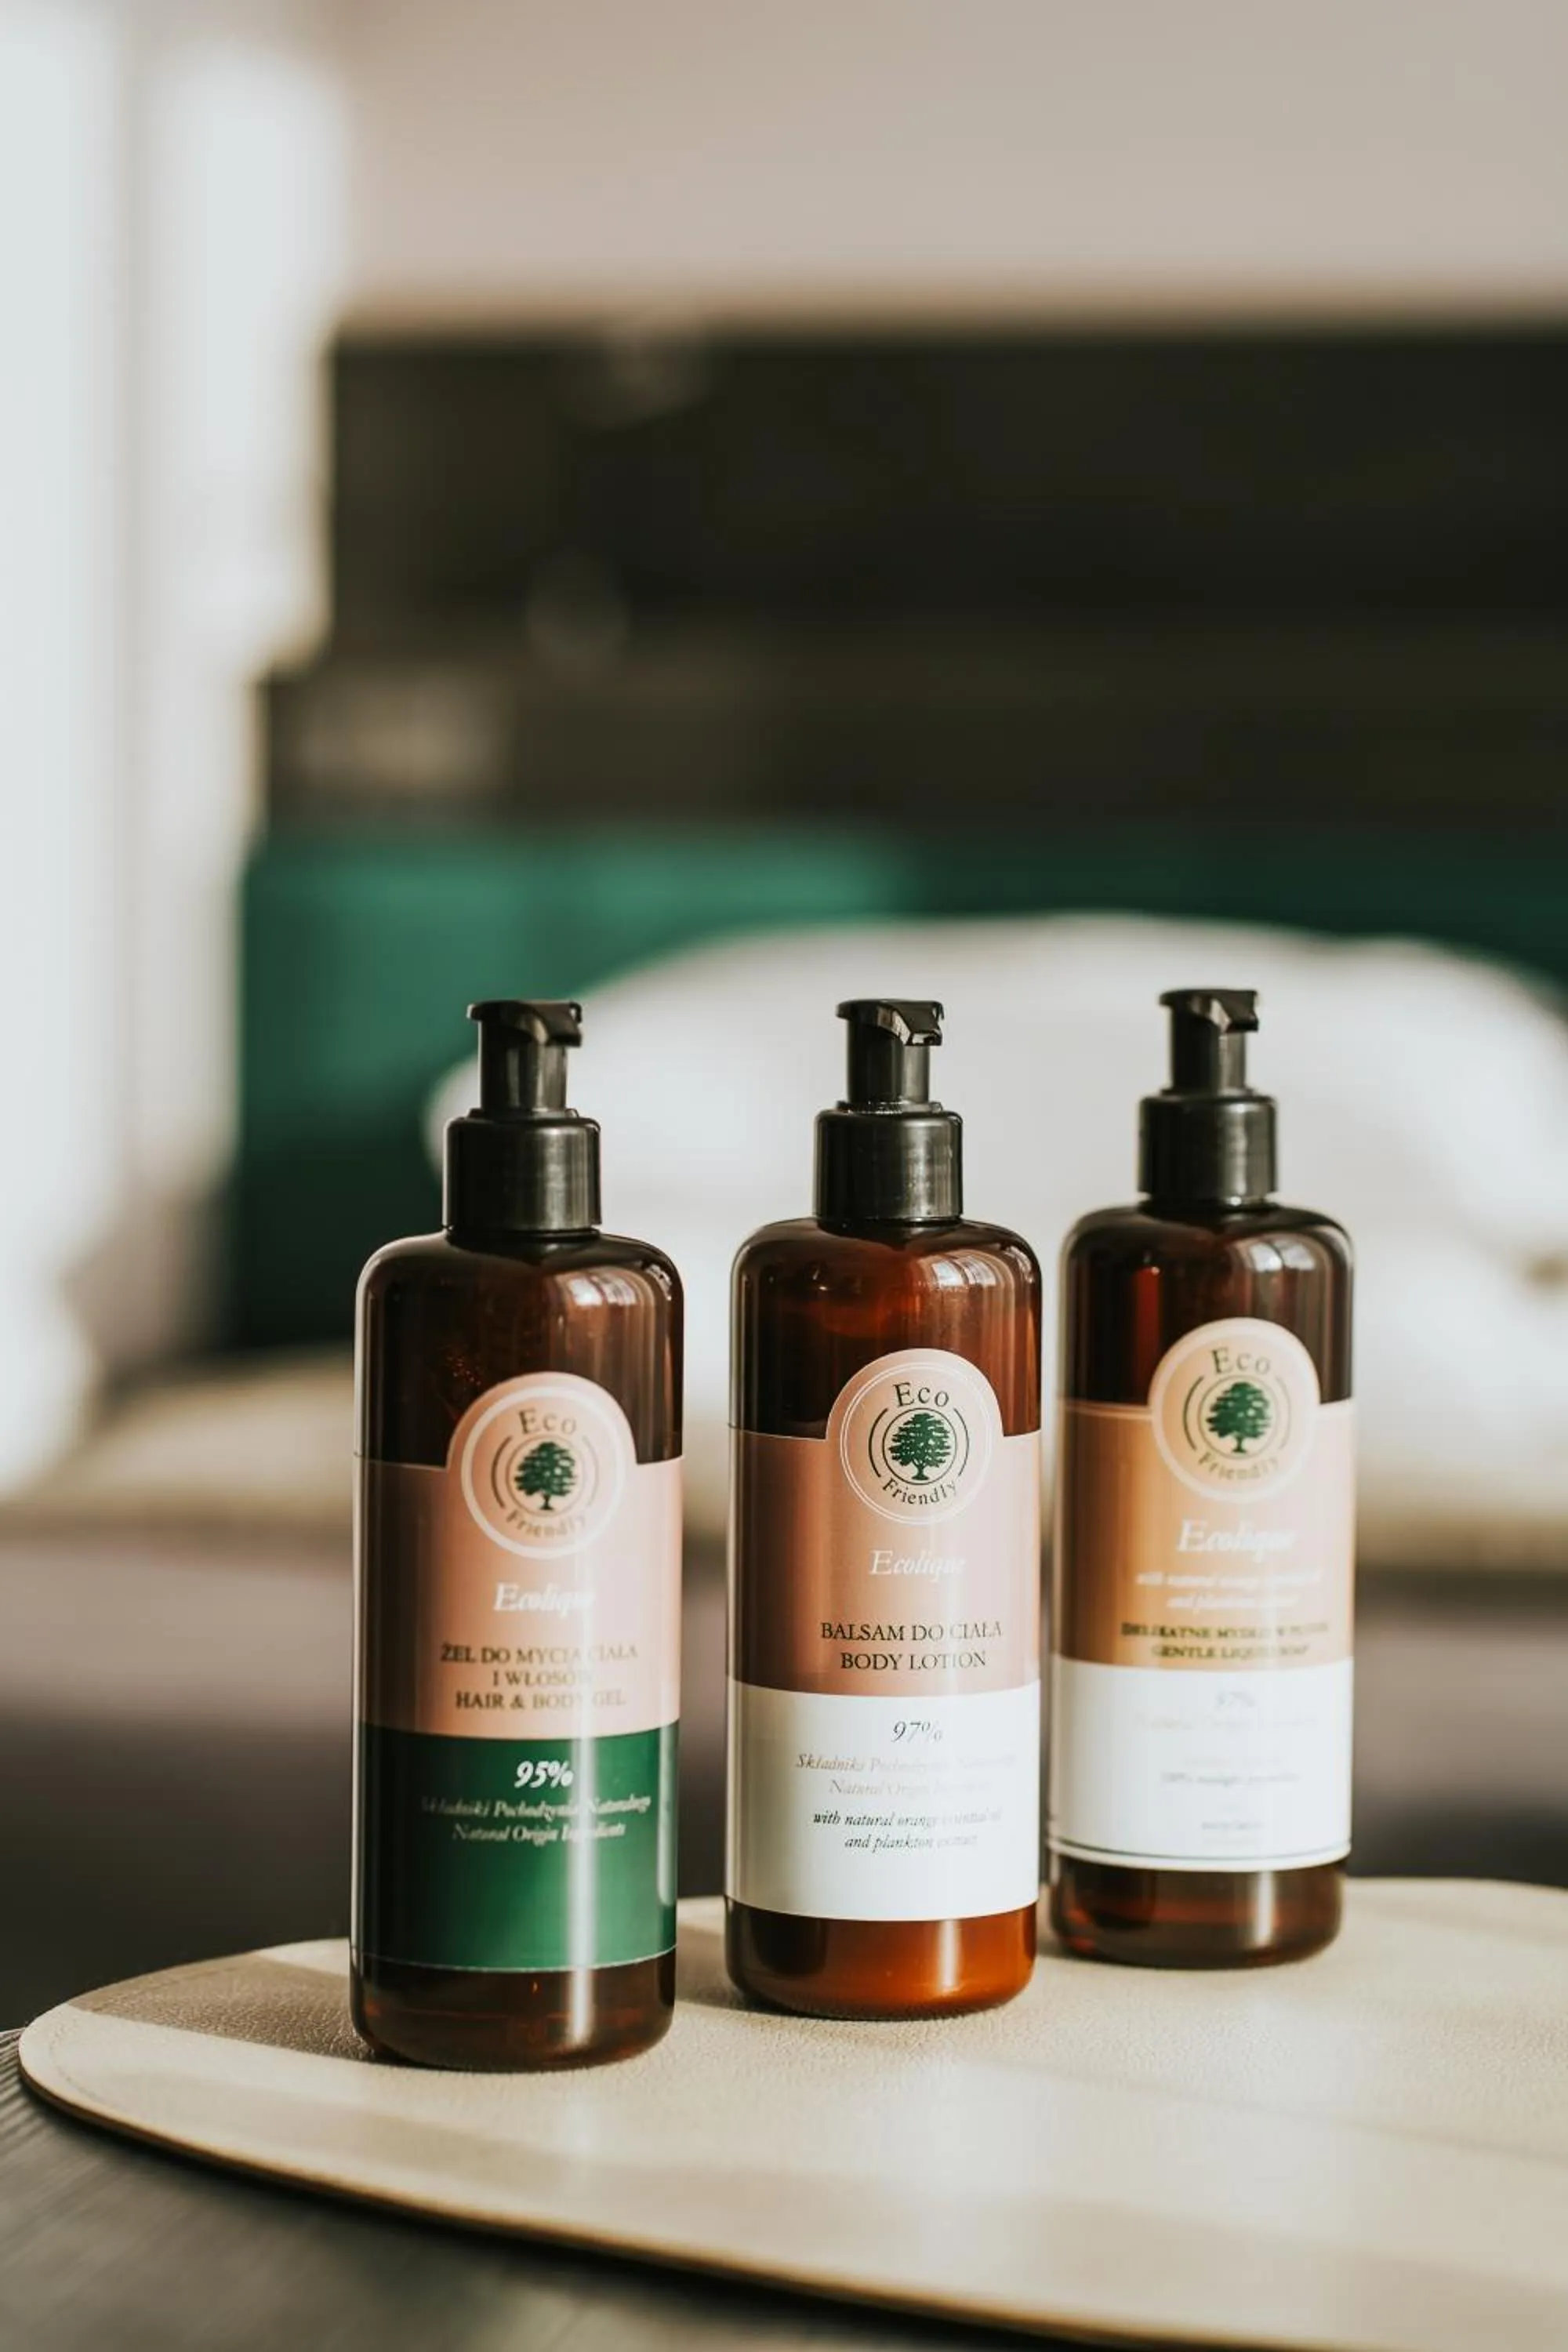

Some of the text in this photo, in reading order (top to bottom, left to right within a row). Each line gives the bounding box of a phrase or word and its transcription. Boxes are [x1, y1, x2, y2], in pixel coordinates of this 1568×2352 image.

[1212, 1347, 1271, 1374] Eco
[893, 1381, 950, 1407] Eco
[518, 1408, 577, 1435] Eco
[1198, 1451, 1279, 1480] Friendly
[882, 1477, 957, 1504] Friendly
[506, 1508, 586, 1537] Friendly
[820, 1621, 905, 1641] BALSAM
[911, 1623, 944, 1642] DO
[480, 1646, 512, 1664] DO
[840, 1650, 986, 1671] BODY LOTION
[493, 1669, 500, 1689] I
[456, 1690, 506, 1710] HAIR
[510, 1693, 525, 1711] &
[591, 1687, 627, 1709] GEL
[891, 1720, 943, 1744] 97%
[514, 1760, 575, 1788] 95%
[813, 1809, 841, 1826] with
[844, 1810, 895, 1827] natural
[844, 1833, 870, 1849] and
